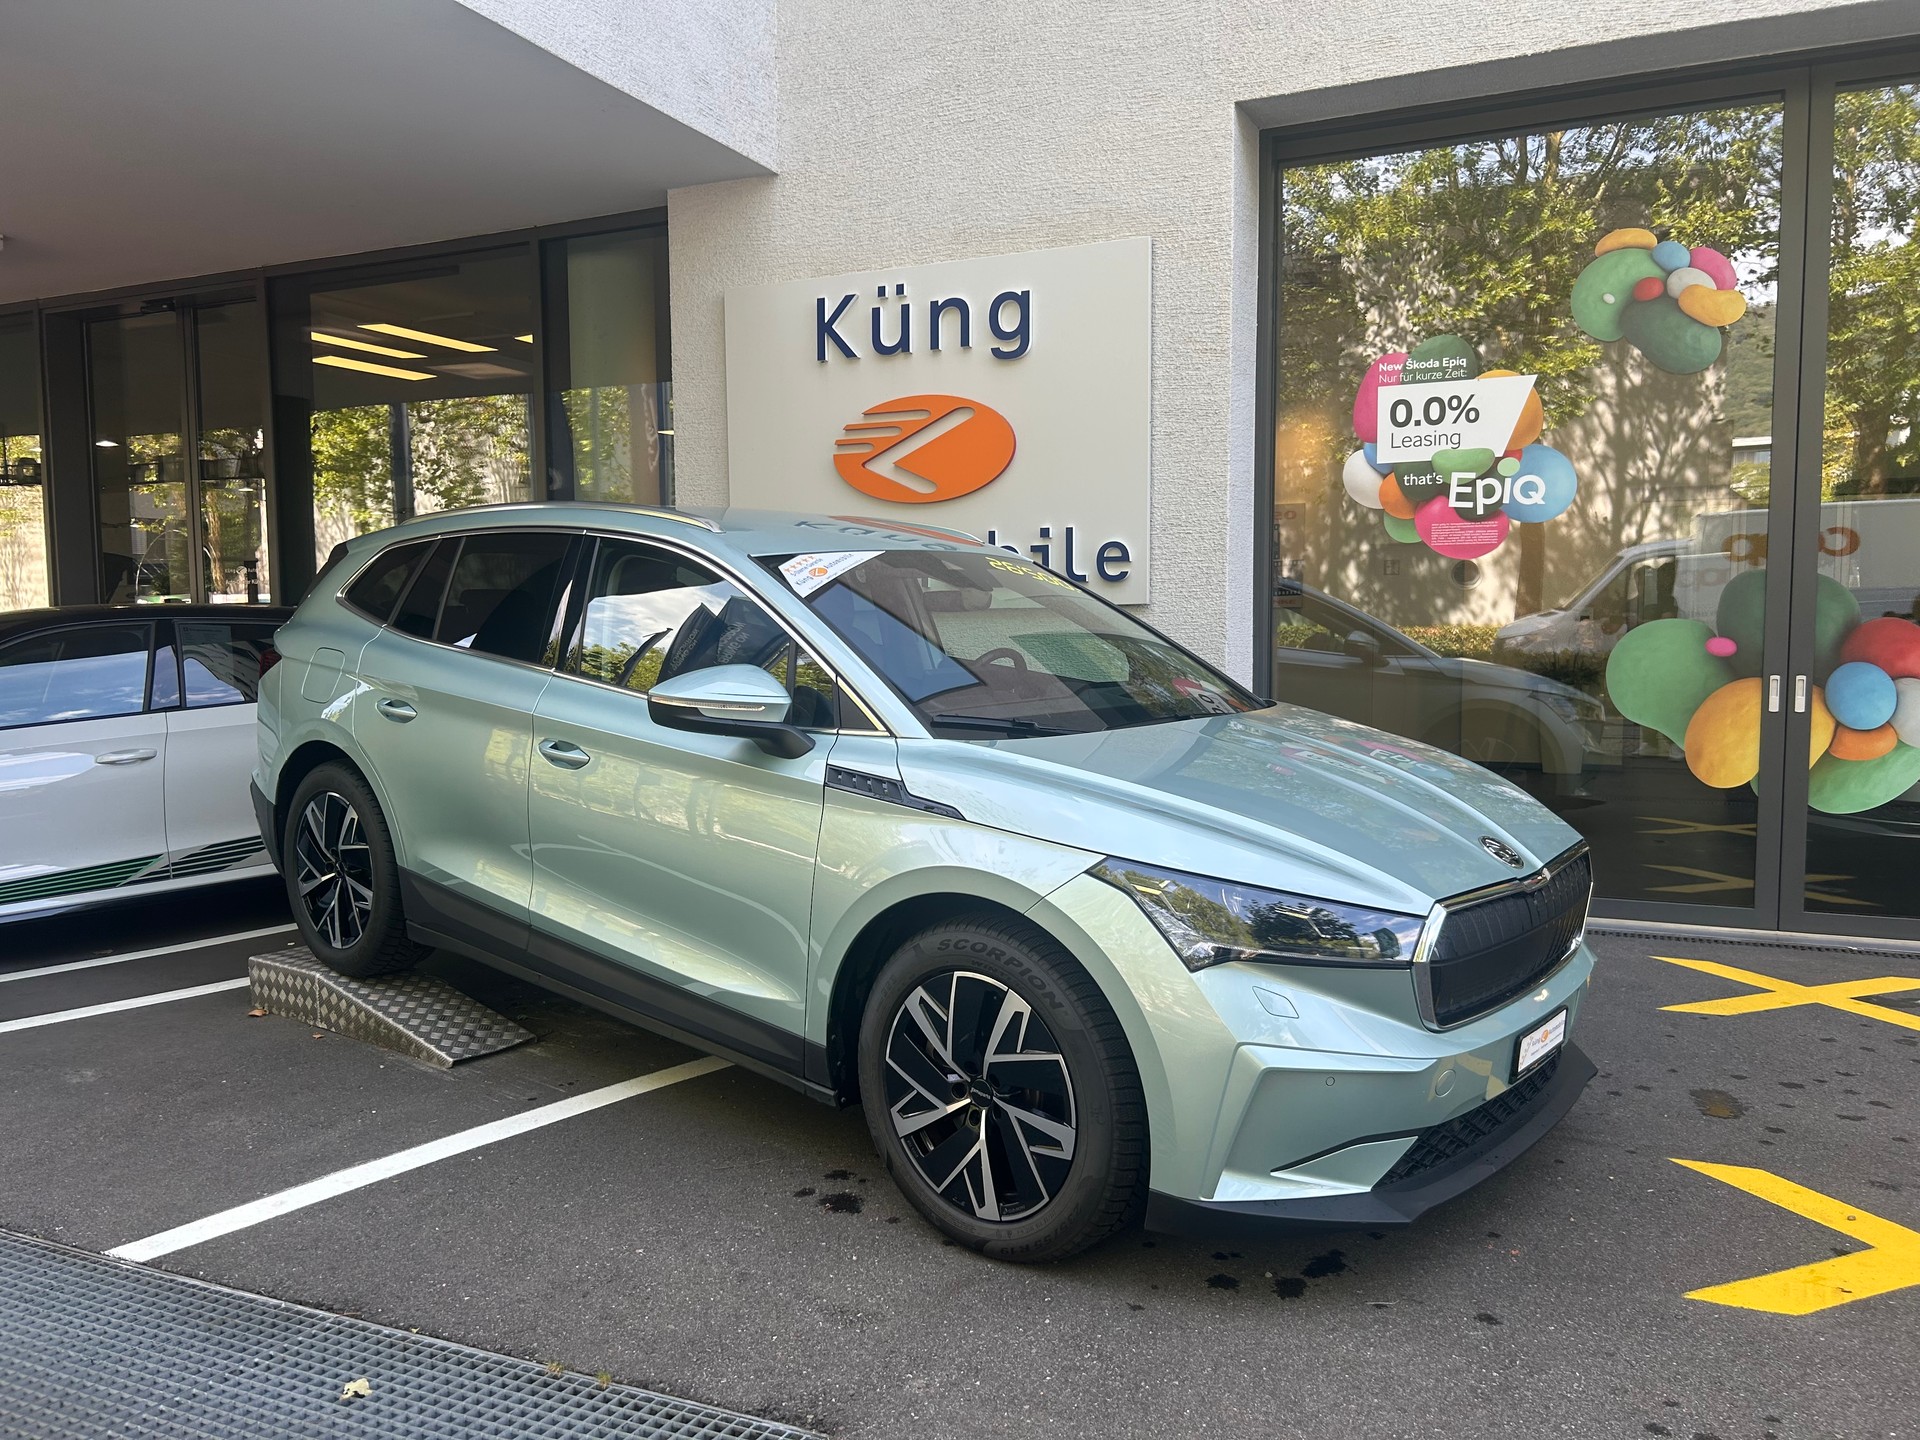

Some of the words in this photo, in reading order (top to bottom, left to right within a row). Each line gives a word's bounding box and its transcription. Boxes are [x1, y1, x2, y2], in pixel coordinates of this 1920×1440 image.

[816, 283, 1033, 363] Küng
[1378, 362, 1403, 372] New
[1405, 357, 1440, 370] Škoda
[1442, 356, 1467, 369] Epiq
[1378, 374, 1398, 383] Nur
[1399, 372, 1414, 382] für
[1415, 371, 1443, 381] kurze
[1389, 394, 1480, 428] 0.0%
[1391, 430, 1461, 449] Leasing
[1403, 473, 1443, 486] that's
[937, 938, 1065, 1009] SCORPION
